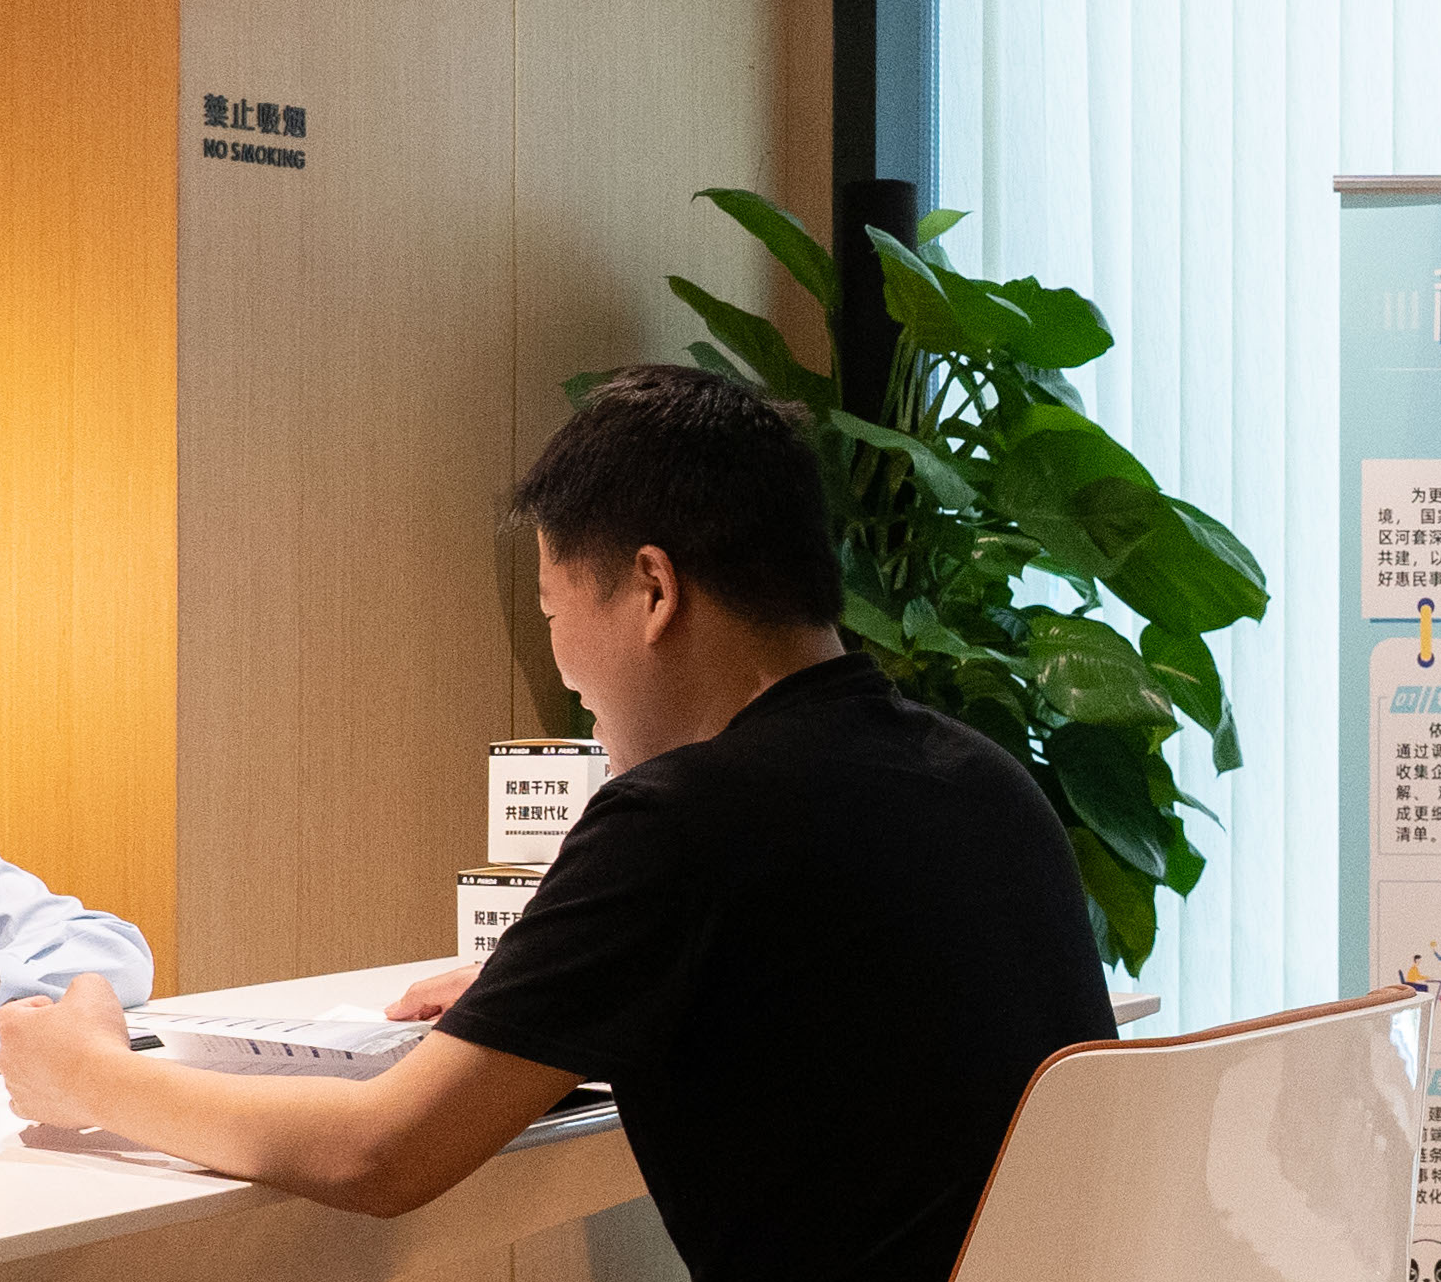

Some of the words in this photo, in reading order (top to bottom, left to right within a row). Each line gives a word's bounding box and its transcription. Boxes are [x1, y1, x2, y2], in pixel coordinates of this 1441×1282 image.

[203, 138, 228, 160] NO
[231, 142, 306, 169] SMOKING
[1395, 692, 1417, 708] 01
[505, 780, 569, 795] 税惠千万家
[505, 805, 569, 821] 共建现代化
[1395, 826, 1438, 843] 清单。
